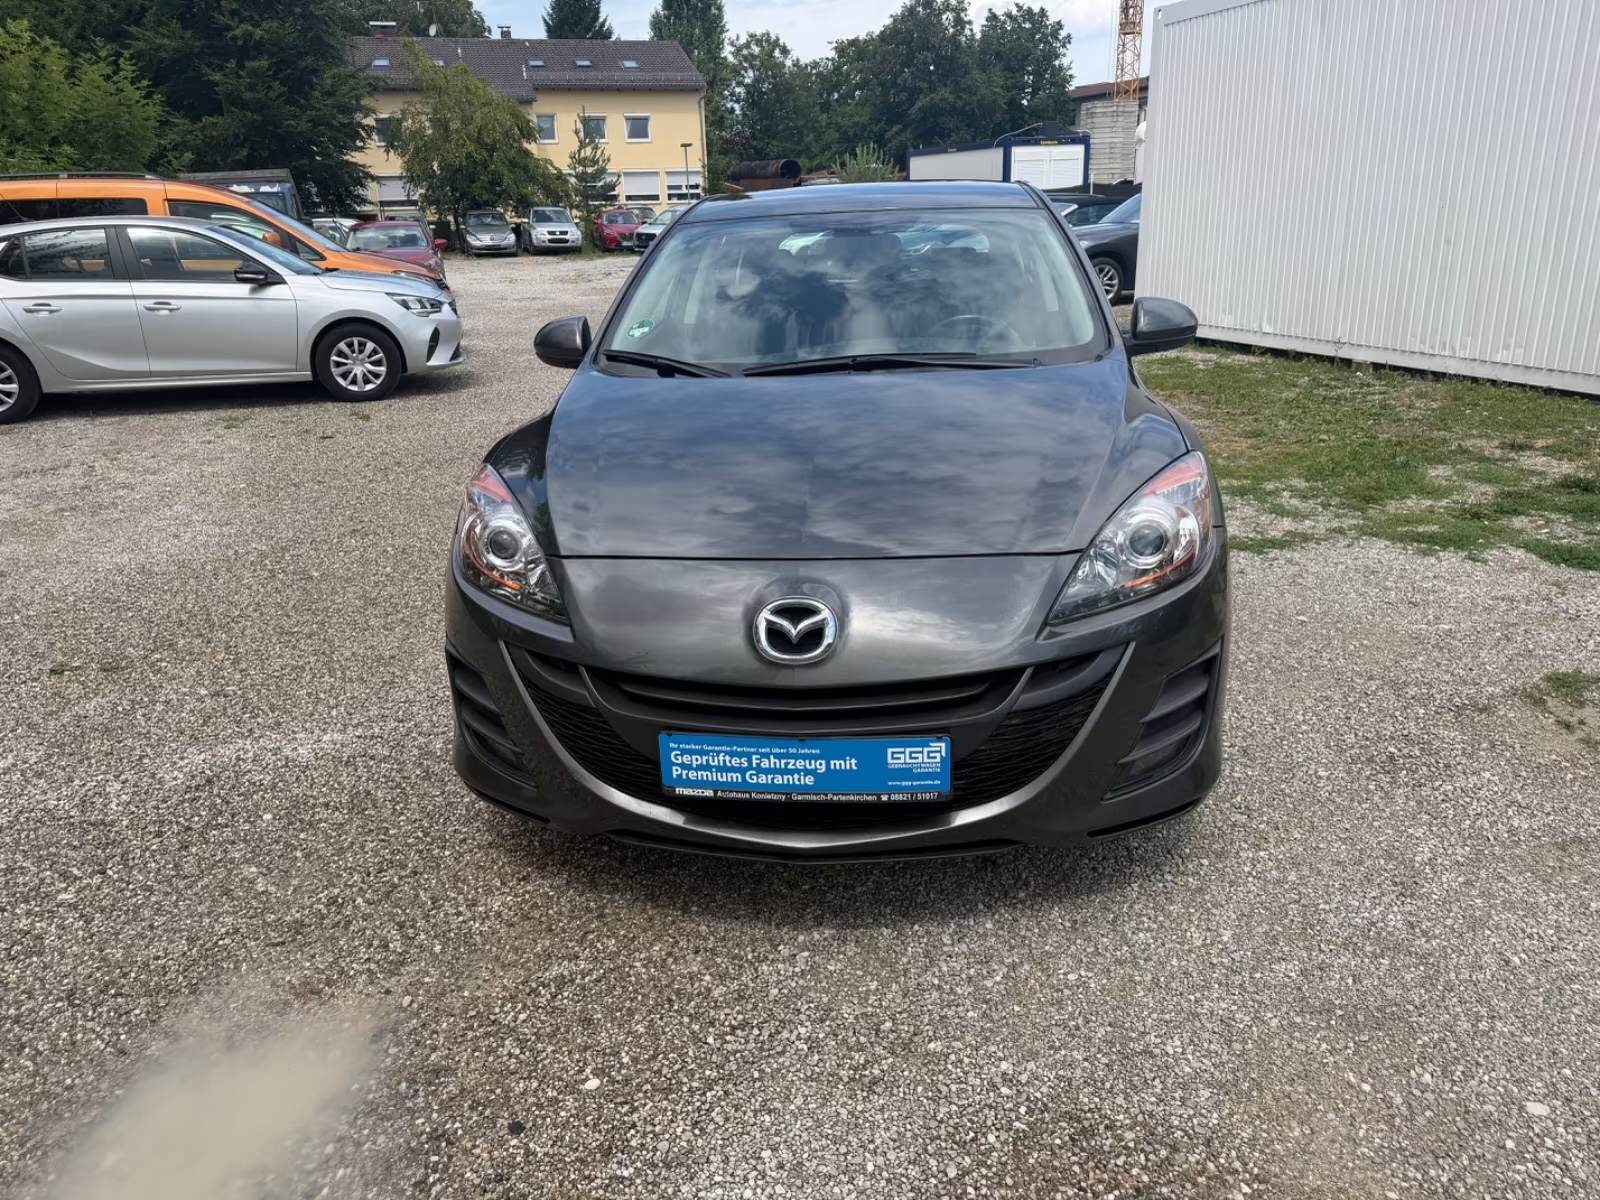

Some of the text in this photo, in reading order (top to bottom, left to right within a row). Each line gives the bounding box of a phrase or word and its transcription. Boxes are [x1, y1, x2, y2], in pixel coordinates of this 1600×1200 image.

[703, 744, 757, 753] Garantie-Partner
[887, 747, 941, 763] GGG
[670, 751, 858, 773] Geprüftes Fahrzeug mit
[672, 766, 815, 785] Premium Garantie
[717, 790, 750, 799] Autohaus
[751, 791, 786, 802] Konietzny
[791, 793, 877, 802] Garmisch-Partenkirchen
[890, 793, 911, 801] 08821
[917, 792, 939, 801] 51017
